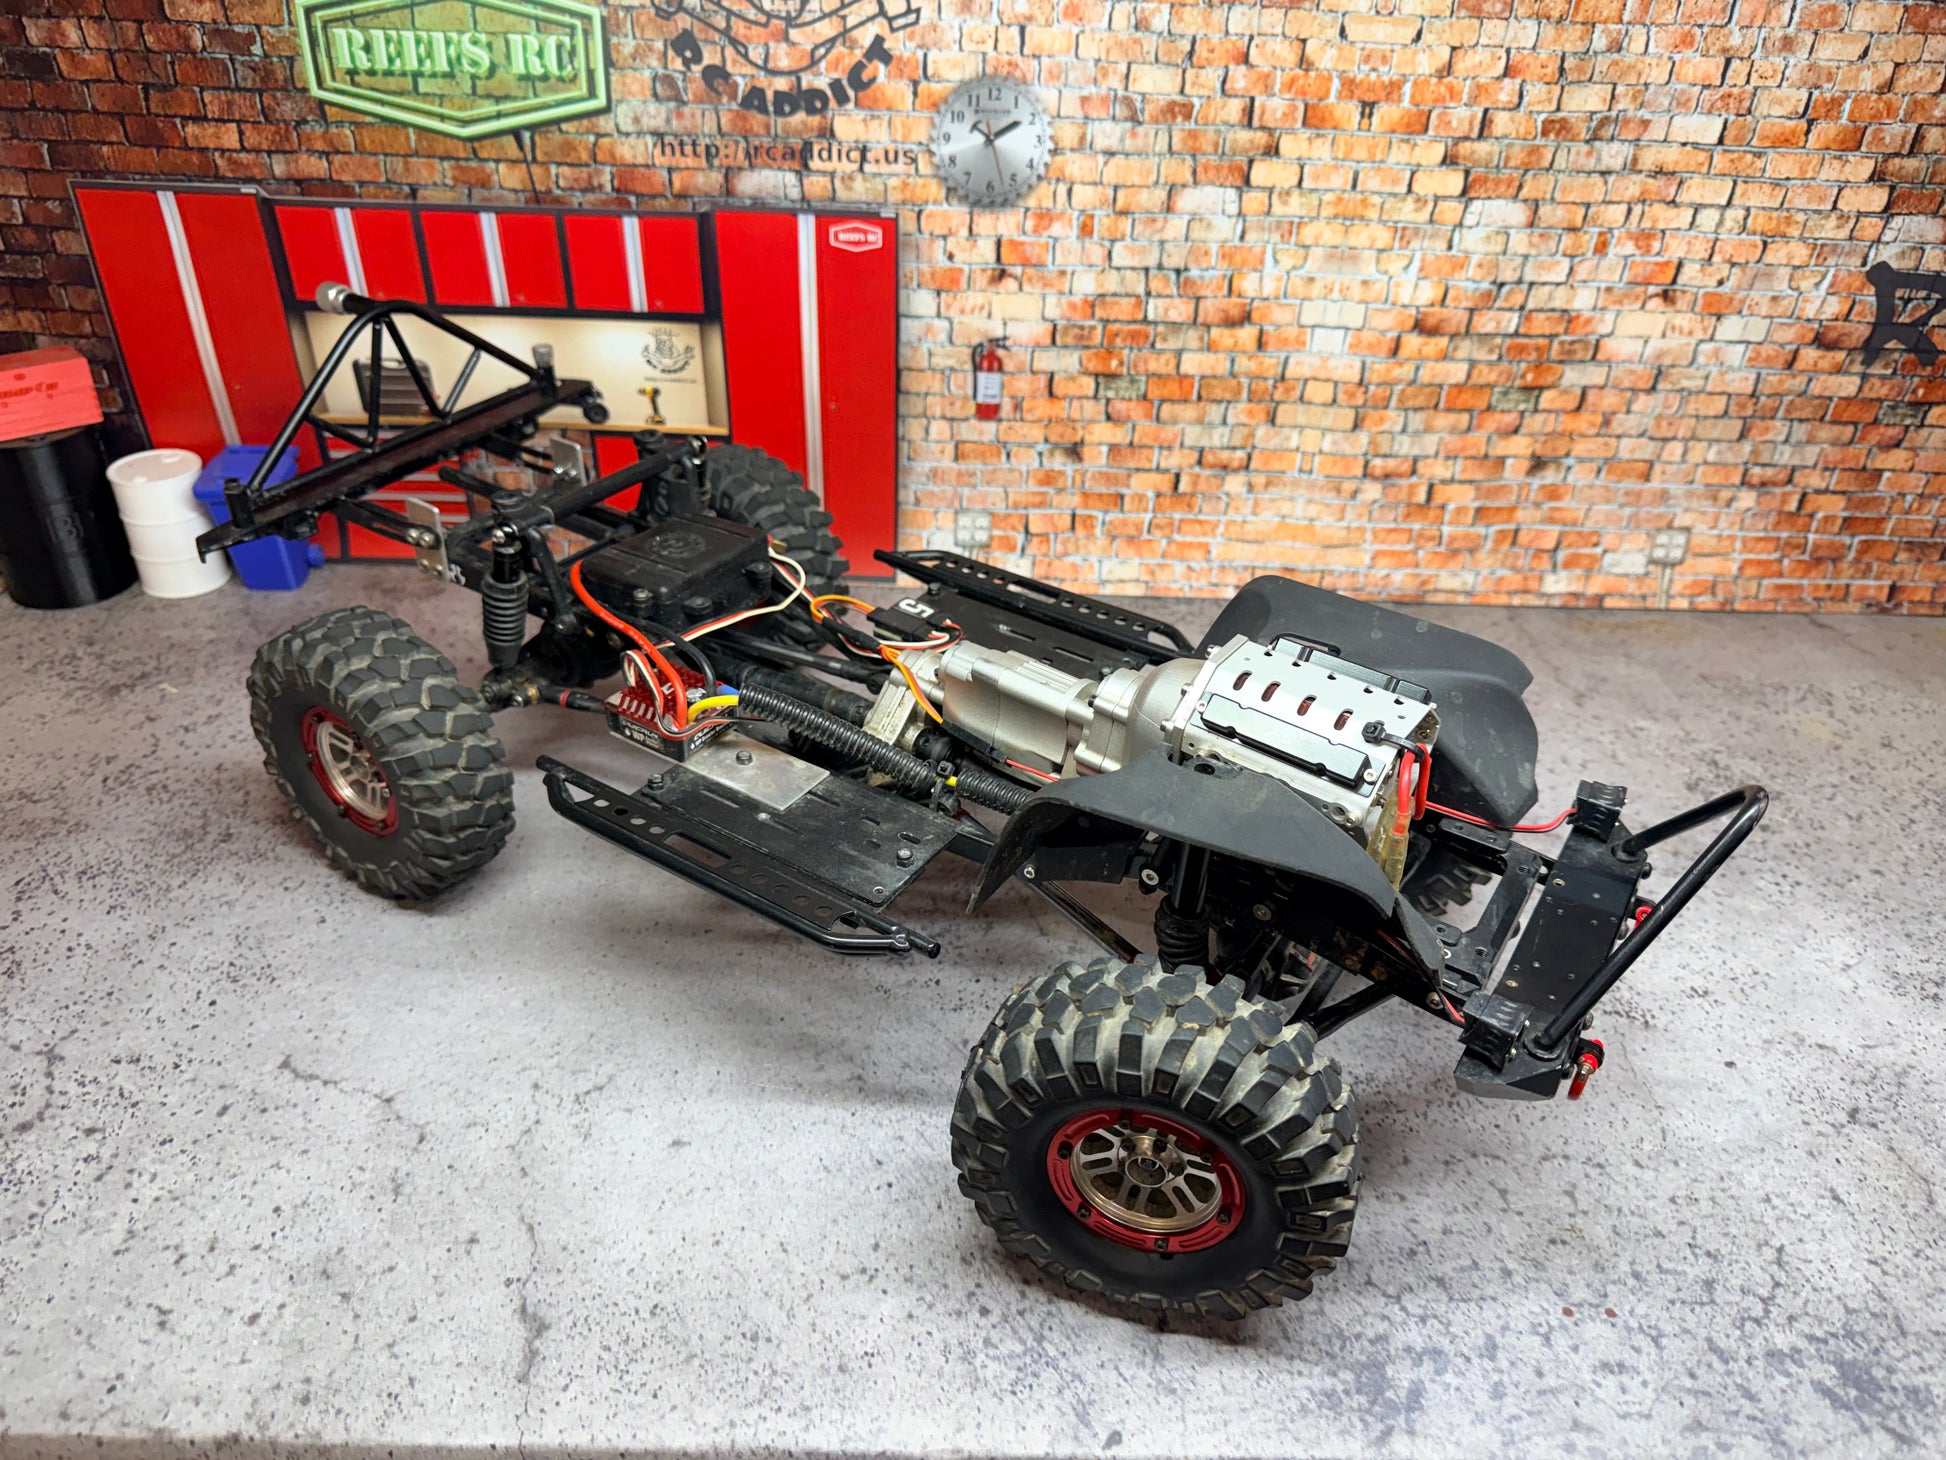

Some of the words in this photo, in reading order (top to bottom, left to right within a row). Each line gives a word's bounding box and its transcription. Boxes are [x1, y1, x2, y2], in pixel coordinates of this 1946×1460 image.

[332, 28, 491, 75] REEFS
[508, 33, 577, 78] RC
[739, 34, 894, 117] ADDICT
[967, 94, 980, 105] 11
[988, 87, 1002, 101] 12
[950, 110, 965, 123] 10
[1028, 112, 1037, 125] 2
[943, 132, 951, 144] 9
[1033, 135, 1043, 149] 3
[948, 155, 957, 169] 8
[1025, 158, 1035, 171] 4
[963, 171, 972, 185] 7
[1009, 173, 1018, 187] 5
[986, 181, 995, 194] 6
